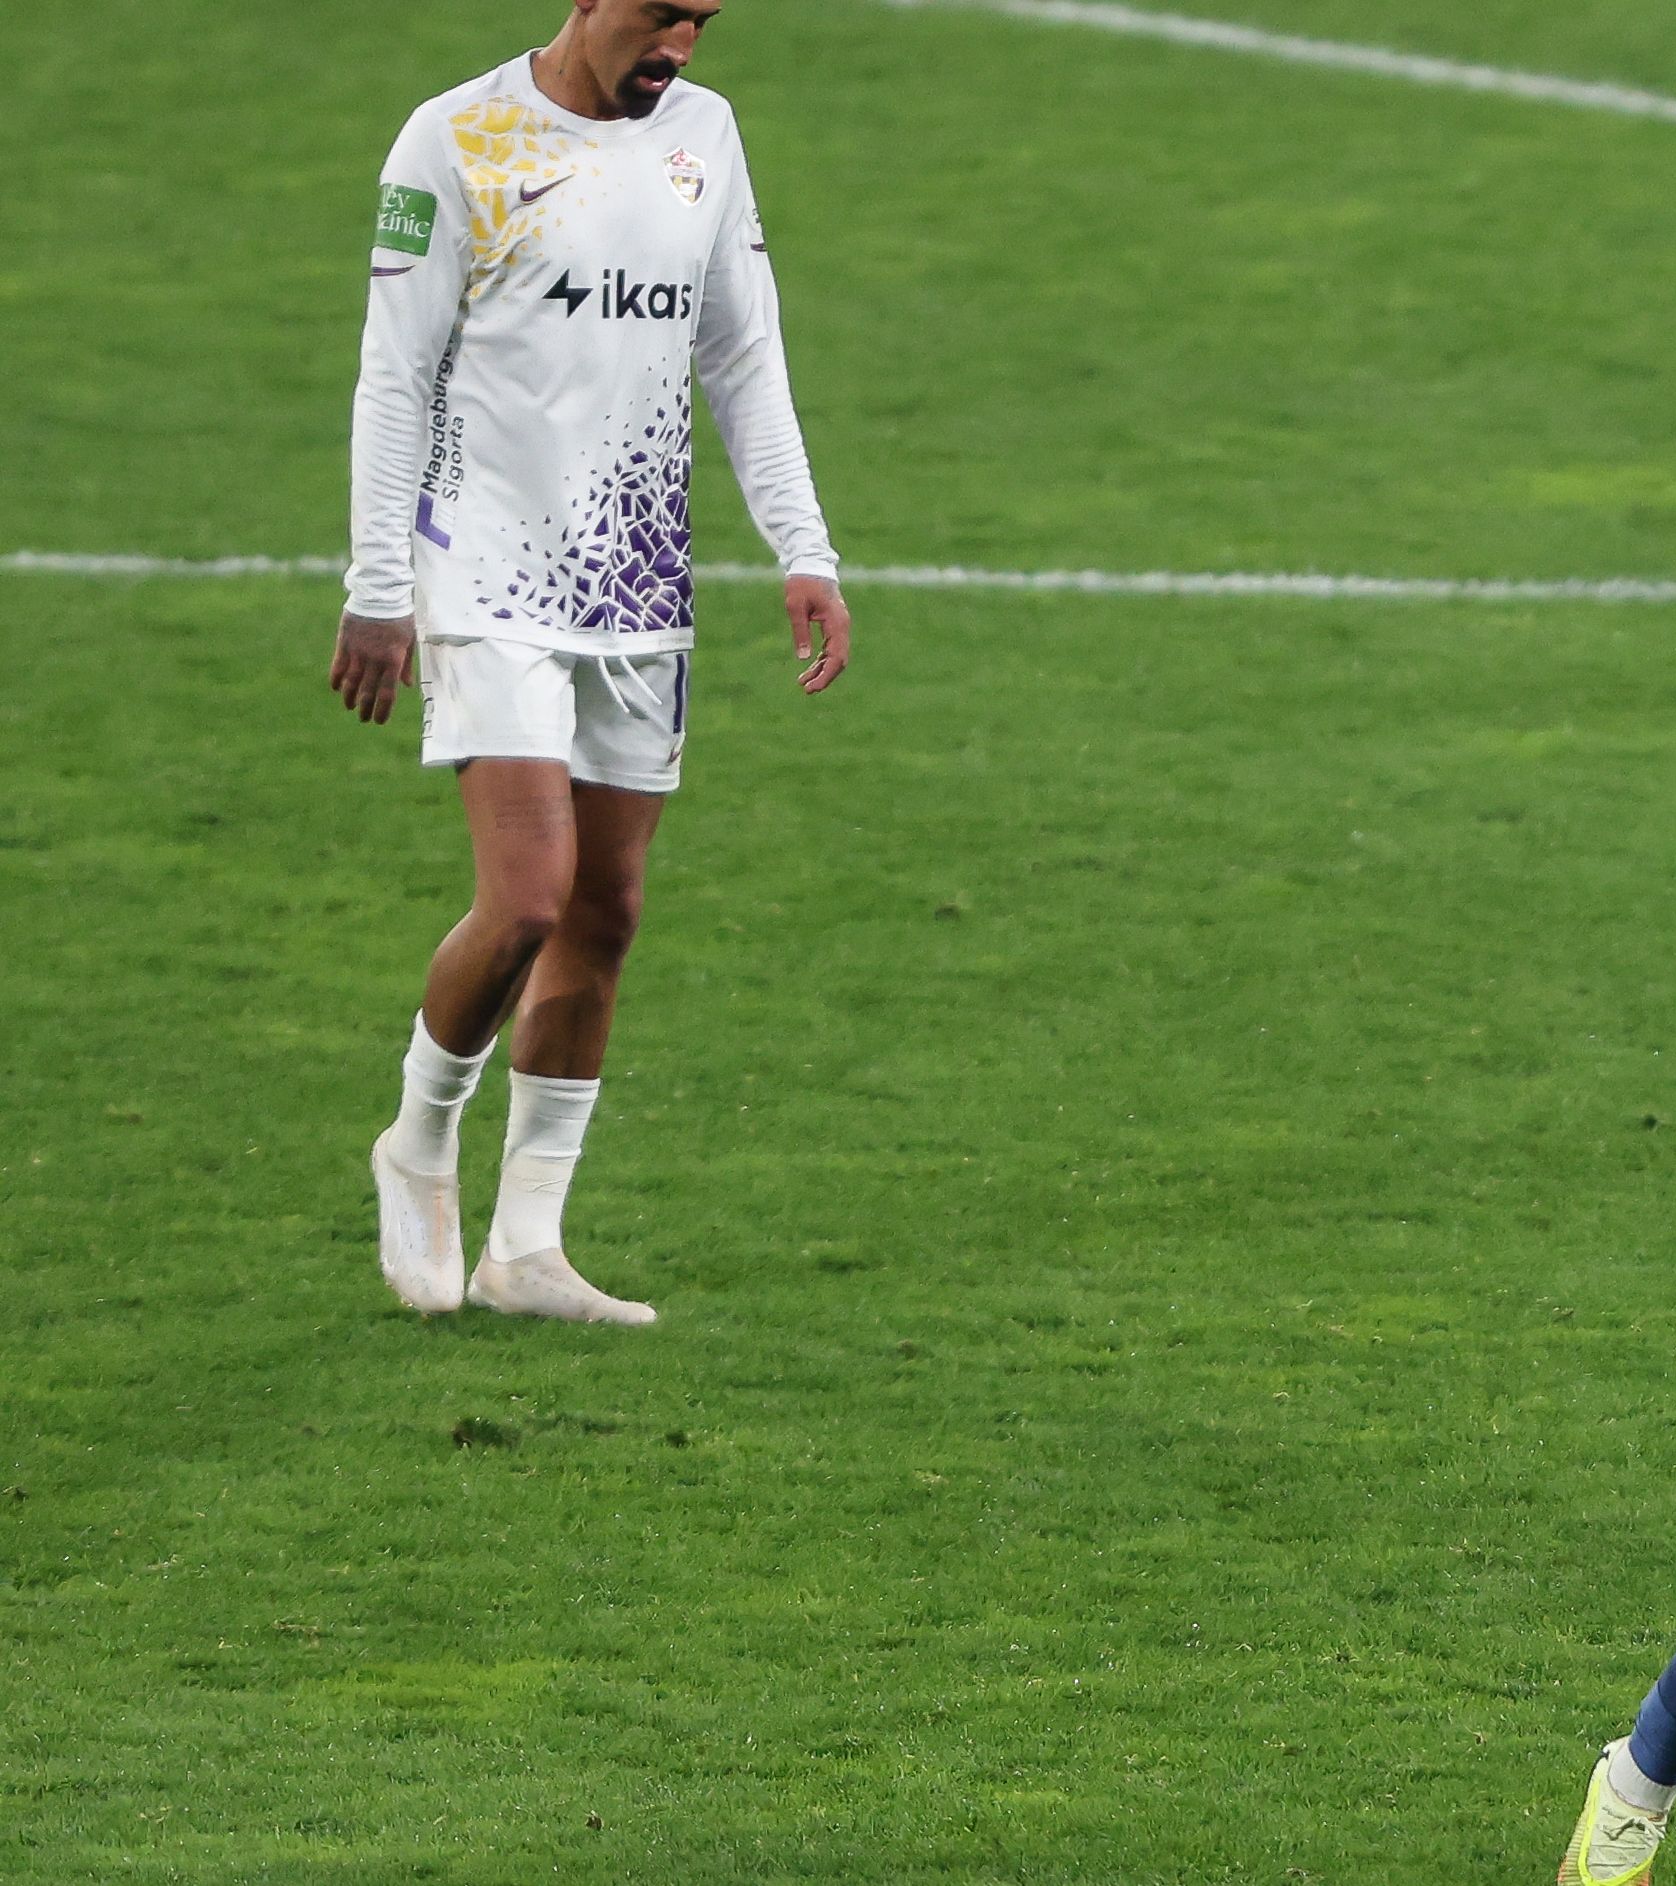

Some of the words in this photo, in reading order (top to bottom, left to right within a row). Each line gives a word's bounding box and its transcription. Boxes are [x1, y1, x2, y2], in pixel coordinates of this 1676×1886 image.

[602, 268, 692, 320] ikas
[420, 339, 455, 493] Magdeburg
[441, 415, 465, 502] Sigorta
